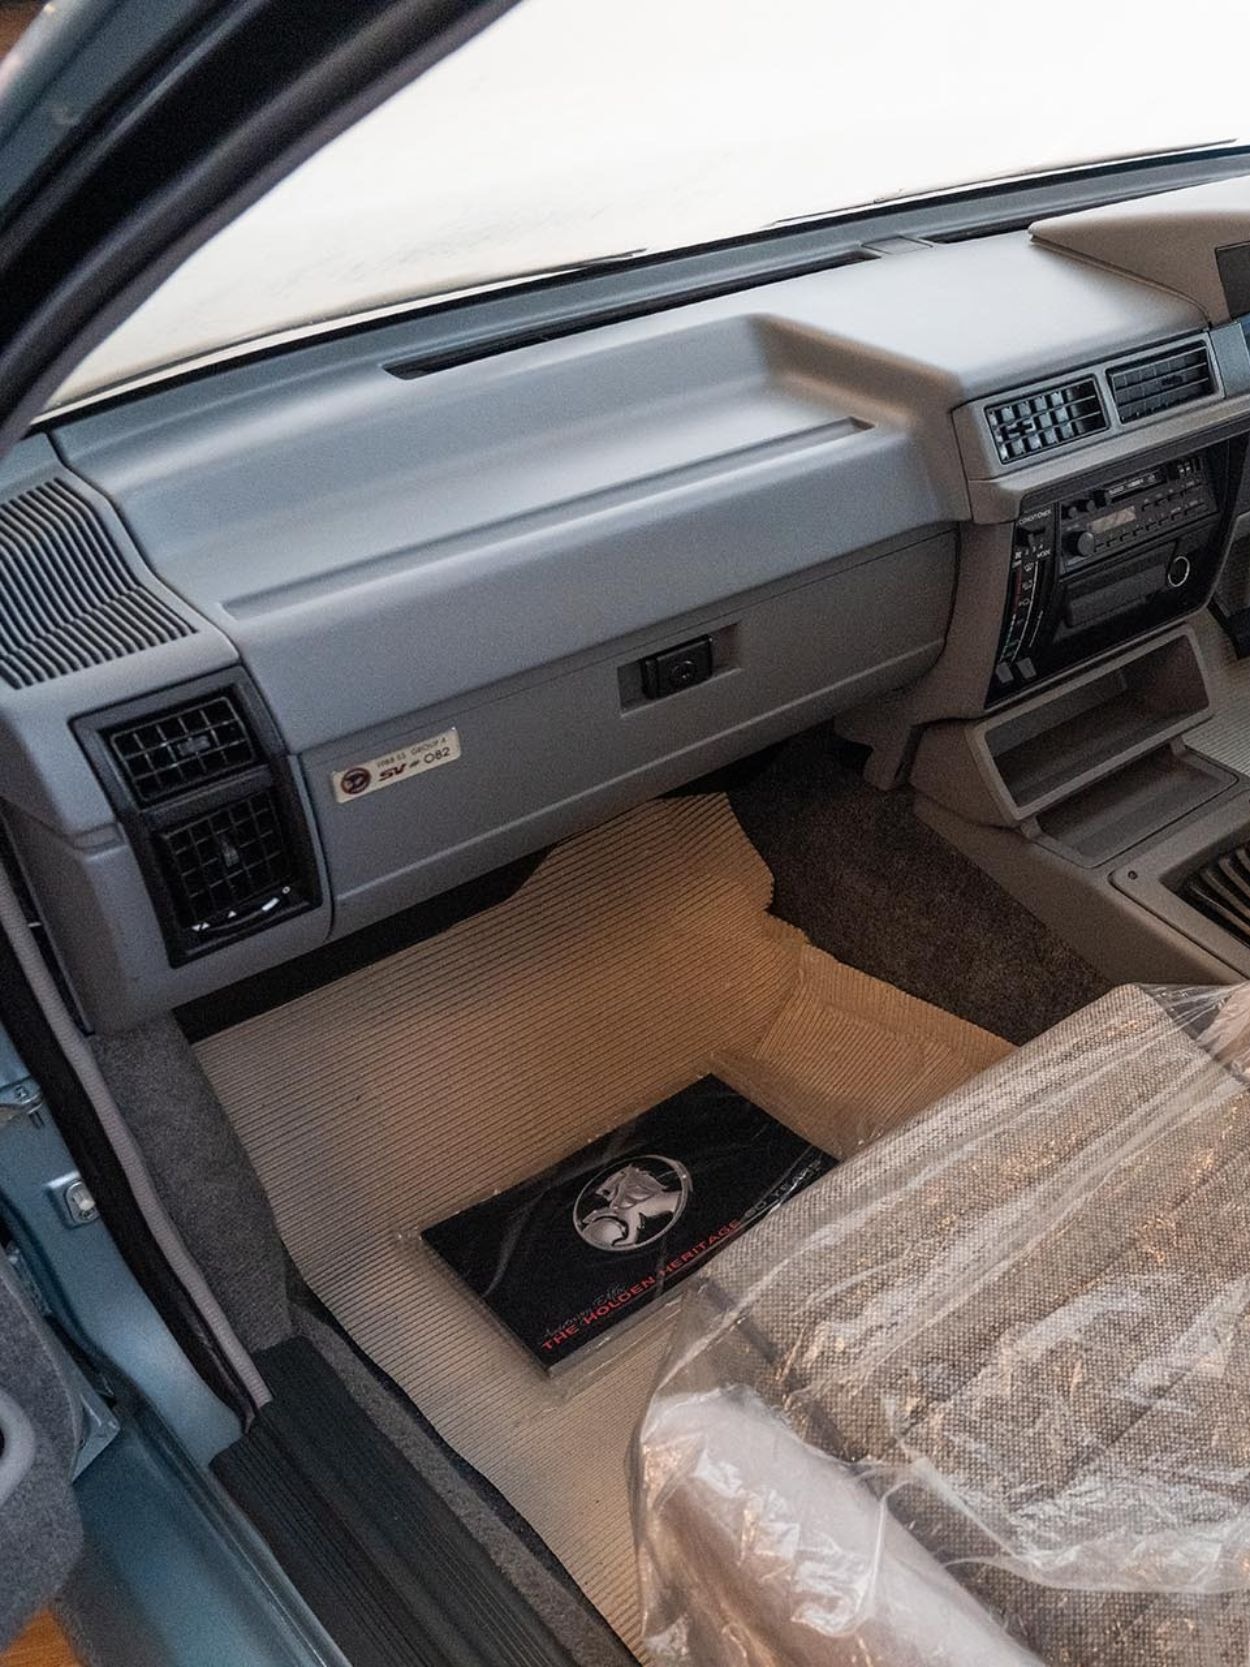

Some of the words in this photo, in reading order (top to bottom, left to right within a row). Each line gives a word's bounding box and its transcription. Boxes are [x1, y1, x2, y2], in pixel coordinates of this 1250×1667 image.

[378, 763, 407, 782] SV
[423, 746, 451, 764] 082
[542, 1323, 579, 1350] THE
[583, 1275, 656, 1325] HOLDEN
[659, 1217, 742, 1277] HERITAGE
